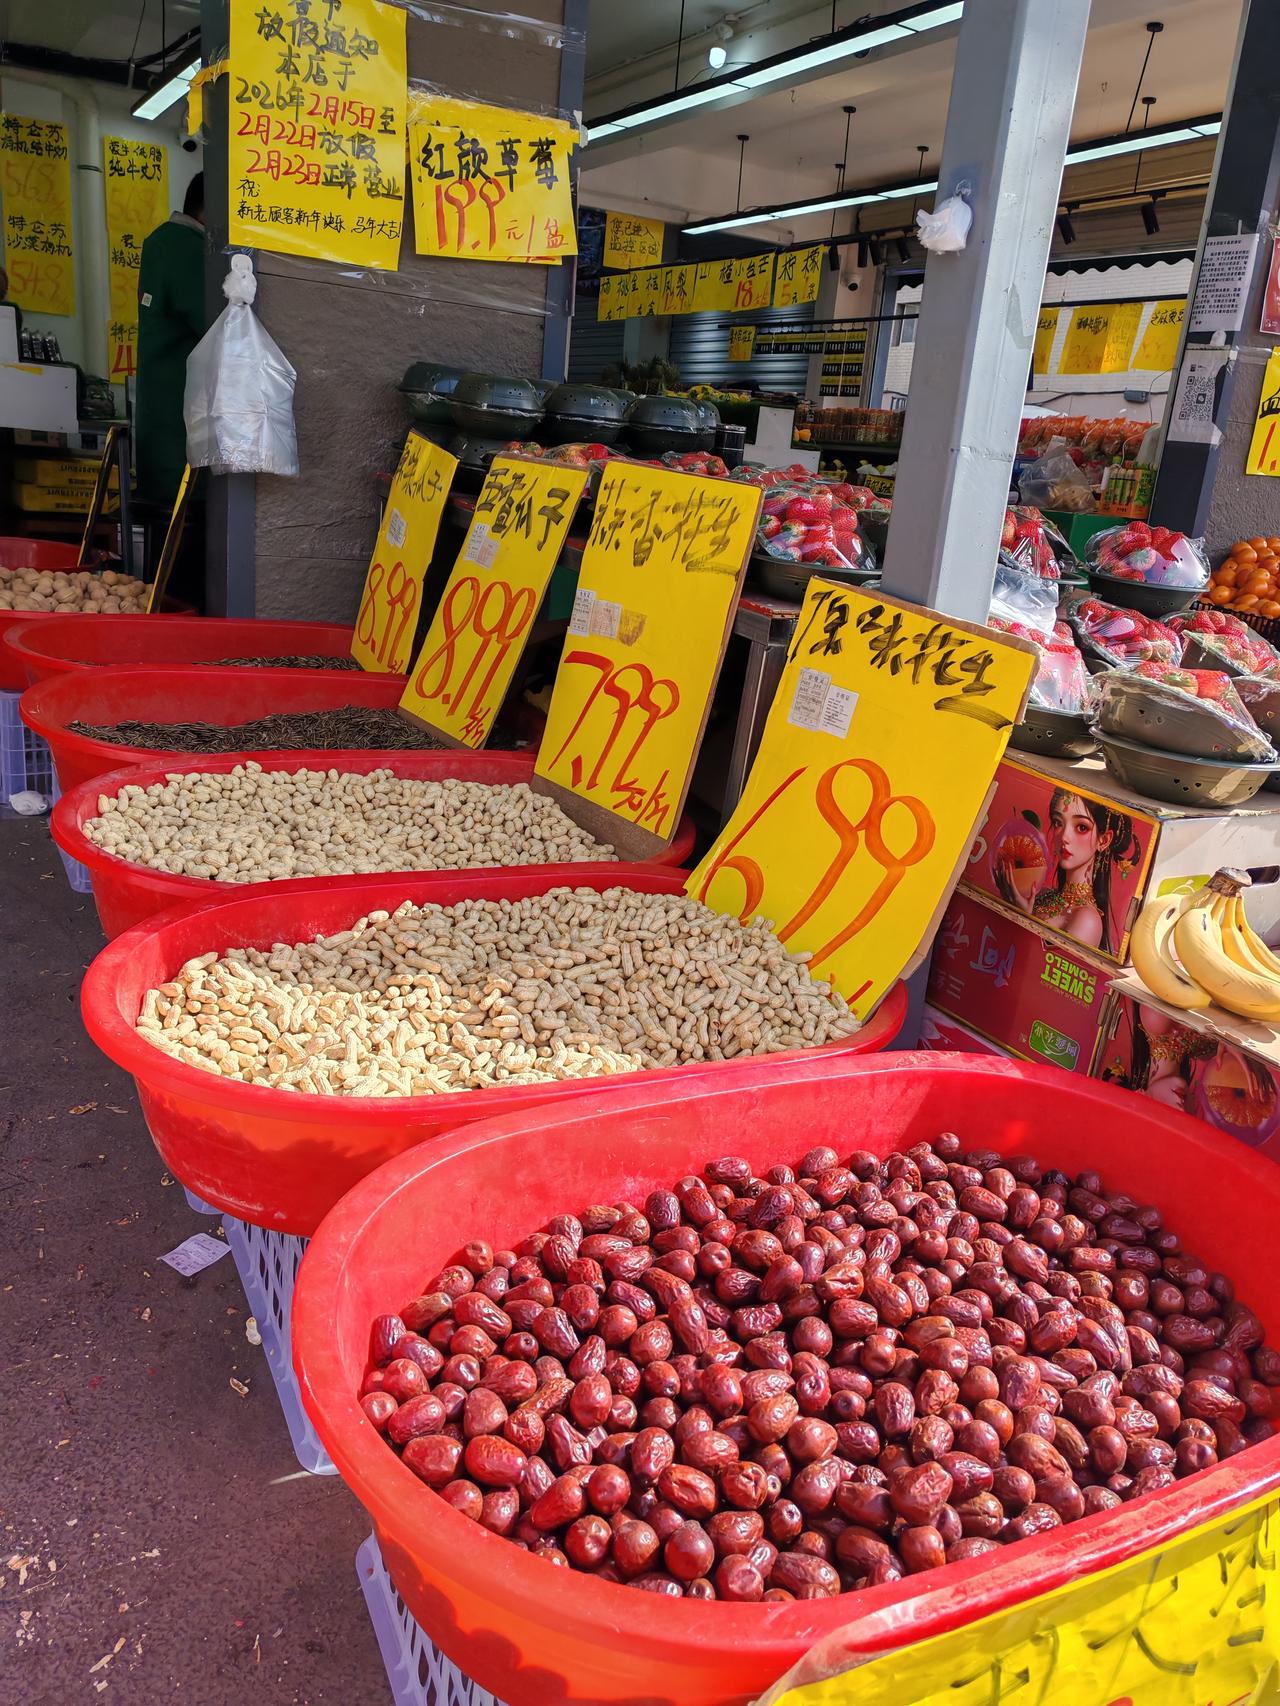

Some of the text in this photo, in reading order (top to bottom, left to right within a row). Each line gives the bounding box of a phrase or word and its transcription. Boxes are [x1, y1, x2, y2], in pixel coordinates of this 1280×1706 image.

[255, 6, 379, 61] 放假通知
[275, 44, 356, 91] 本店于
[237, 112, 378, 163] 2月22日放假
[421, 131, 559, 192] 红颜草莓
[246, 149, 403, 200] 2月23日正常营业
[435, 177, 506, 253] 19.9
[477, 467, 571, 552] 五香瓜子
[790, 590, 1014, 732] 原味花生
[548, 651, 680, 791] 7.99
[1040, 965, 1096, 1005] SWEET
[1043, 951, 1097, 986] POMELO
